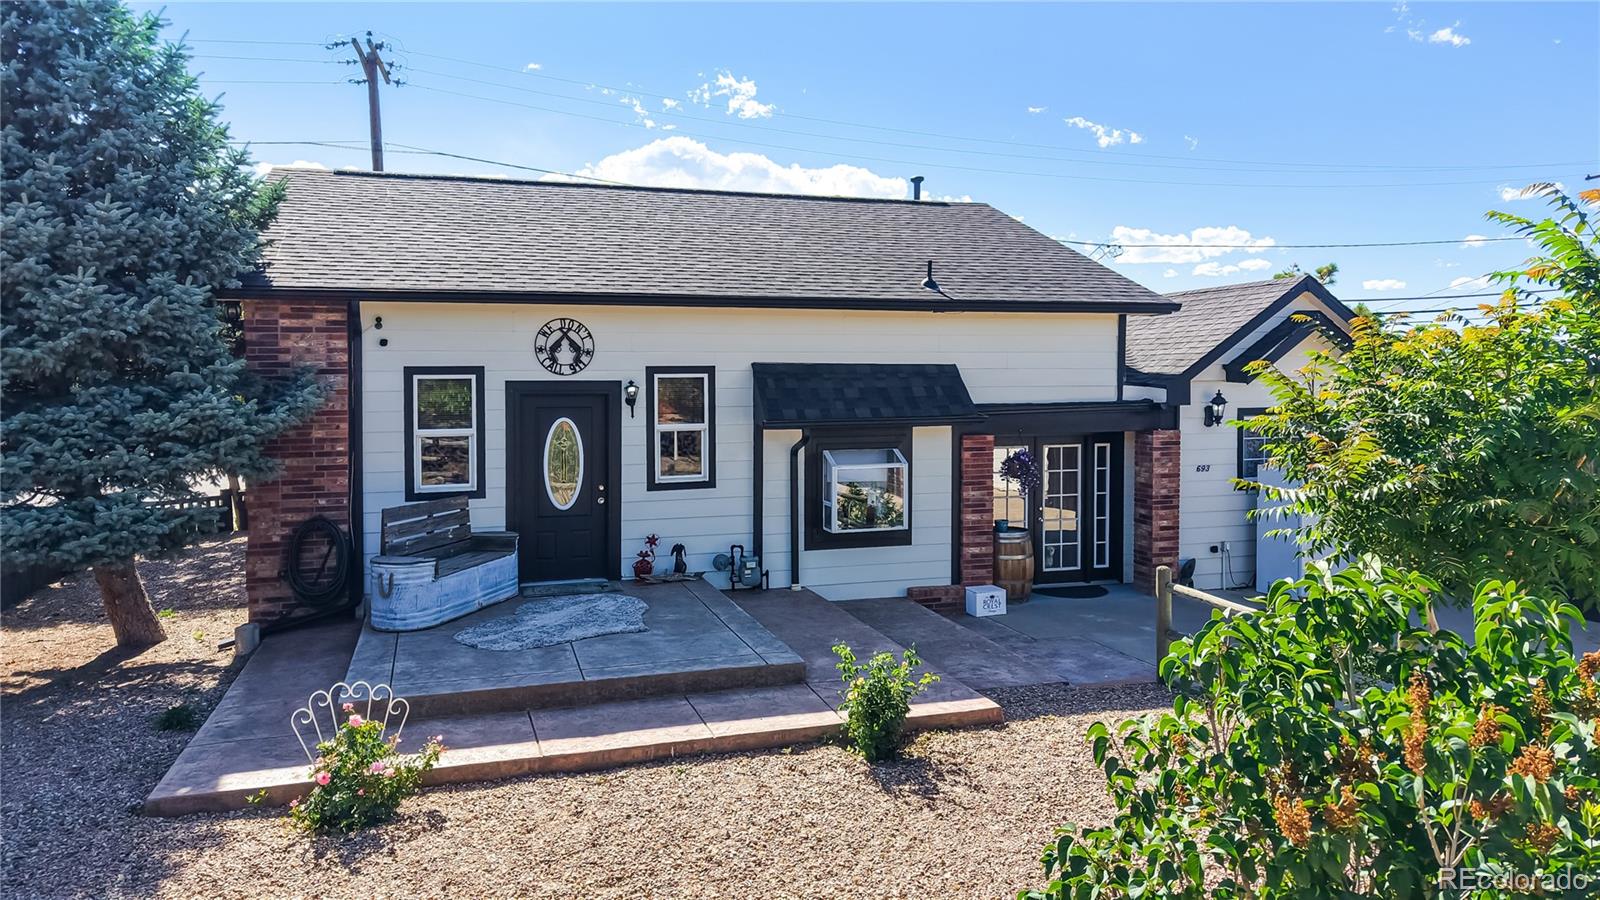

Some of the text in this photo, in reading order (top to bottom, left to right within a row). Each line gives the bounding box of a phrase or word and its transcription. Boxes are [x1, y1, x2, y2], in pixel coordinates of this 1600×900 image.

[541, 357, 588, 375] CALL 911
[1196, 464, 1210, 473] 693
